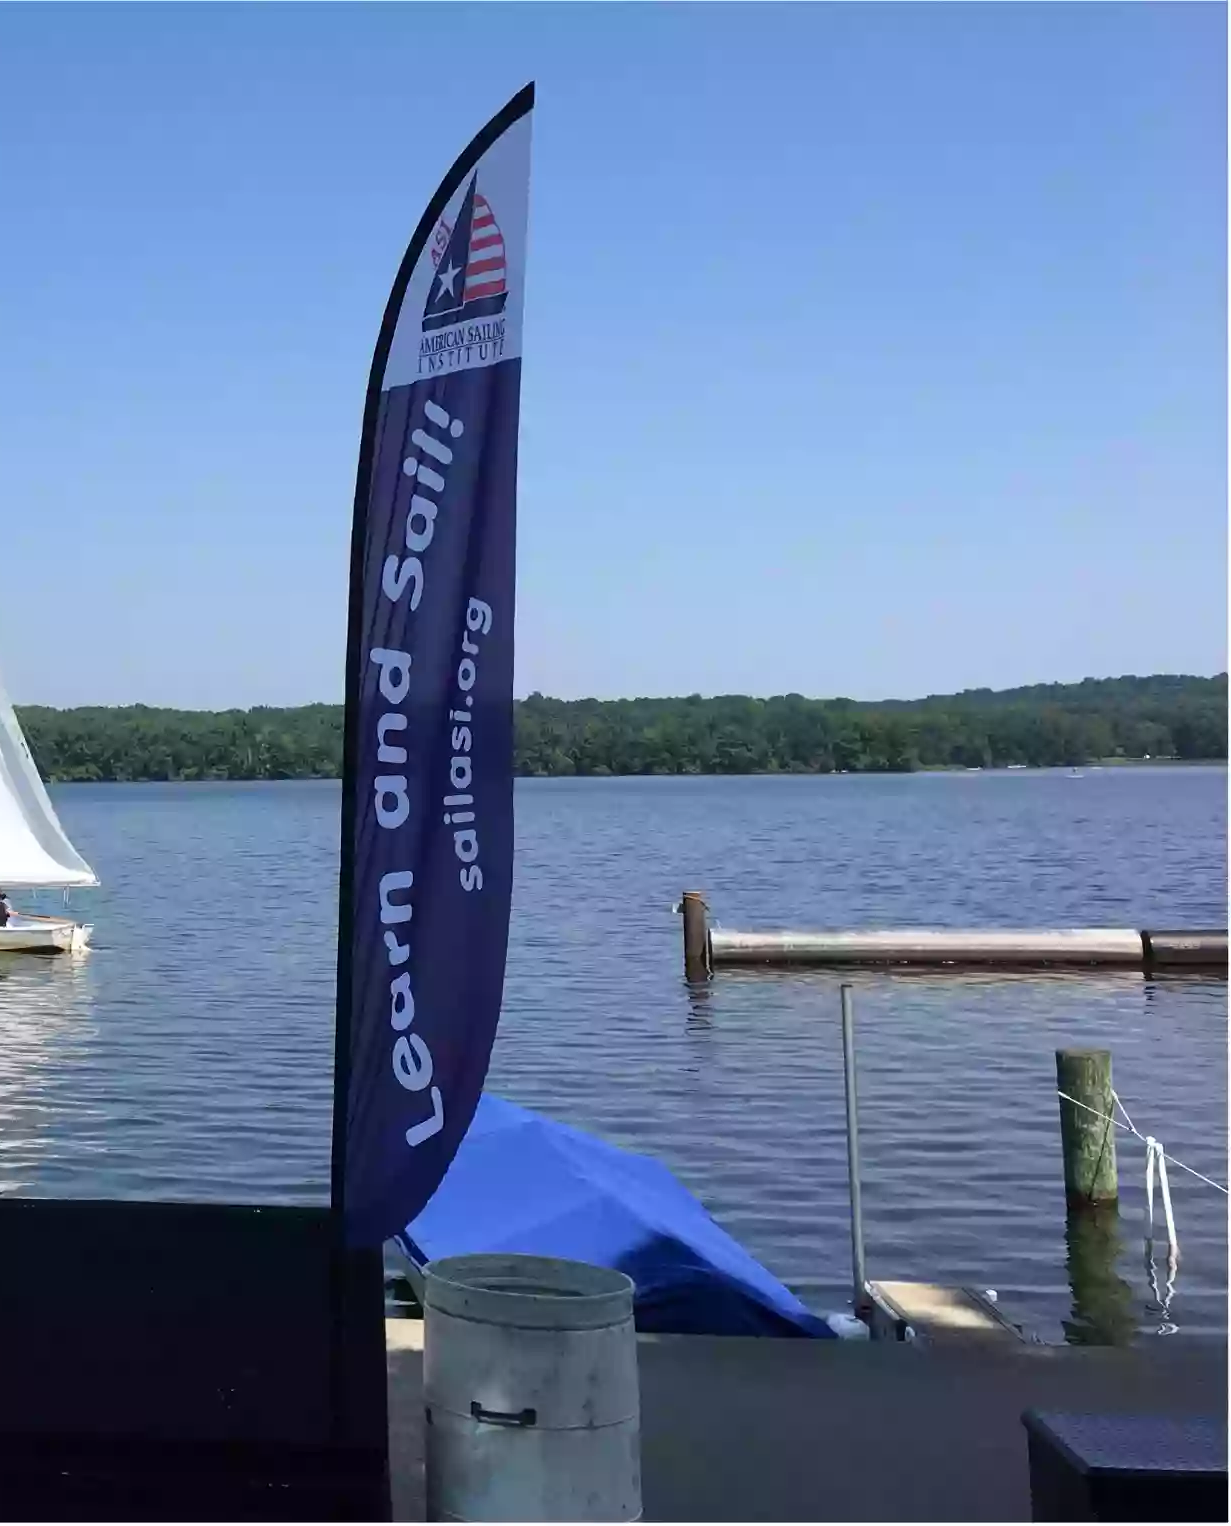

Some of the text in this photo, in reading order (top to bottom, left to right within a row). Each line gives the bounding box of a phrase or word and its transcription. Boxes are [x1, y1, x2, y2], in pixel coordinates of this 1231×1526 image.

[430, 217, 452, 269] ASI
[419, 318, 506, 355] AMERICAN SAILING
[369, 399, 464, 1147] Learn and Sail!
[443, 597, 493, 892] sailasi.org
